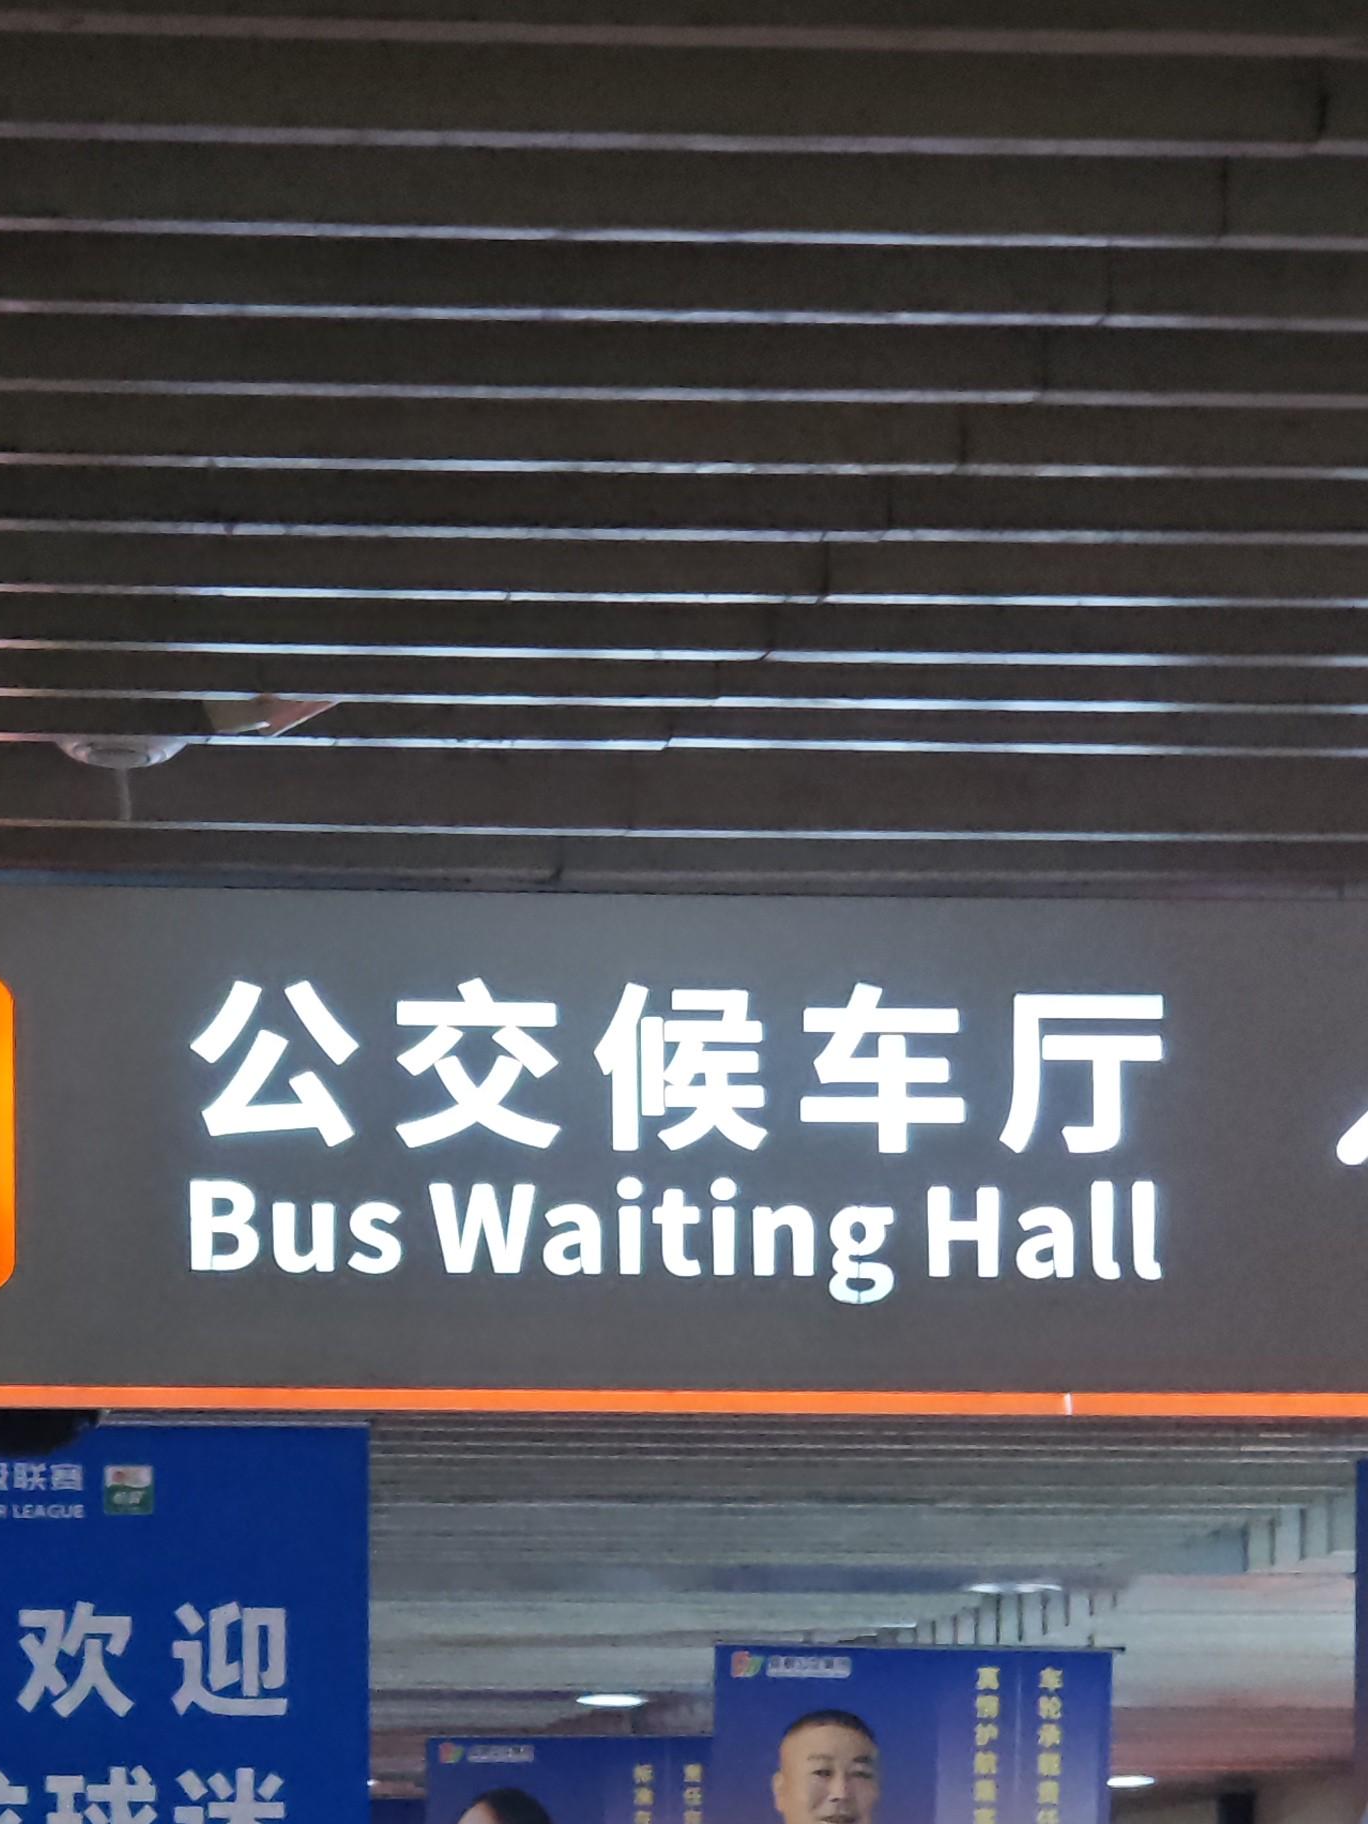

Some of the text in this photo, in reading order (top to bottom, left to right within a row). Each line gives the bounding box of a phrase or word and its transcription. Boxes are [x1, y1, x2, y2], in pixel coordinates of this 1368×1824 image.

[190, 978, 1163, 1153] 公交候车厅
[190, 1176, 1161, 1303] Bus Waiting Hall
[12, 1503, 84, 1519] LEAGUE
